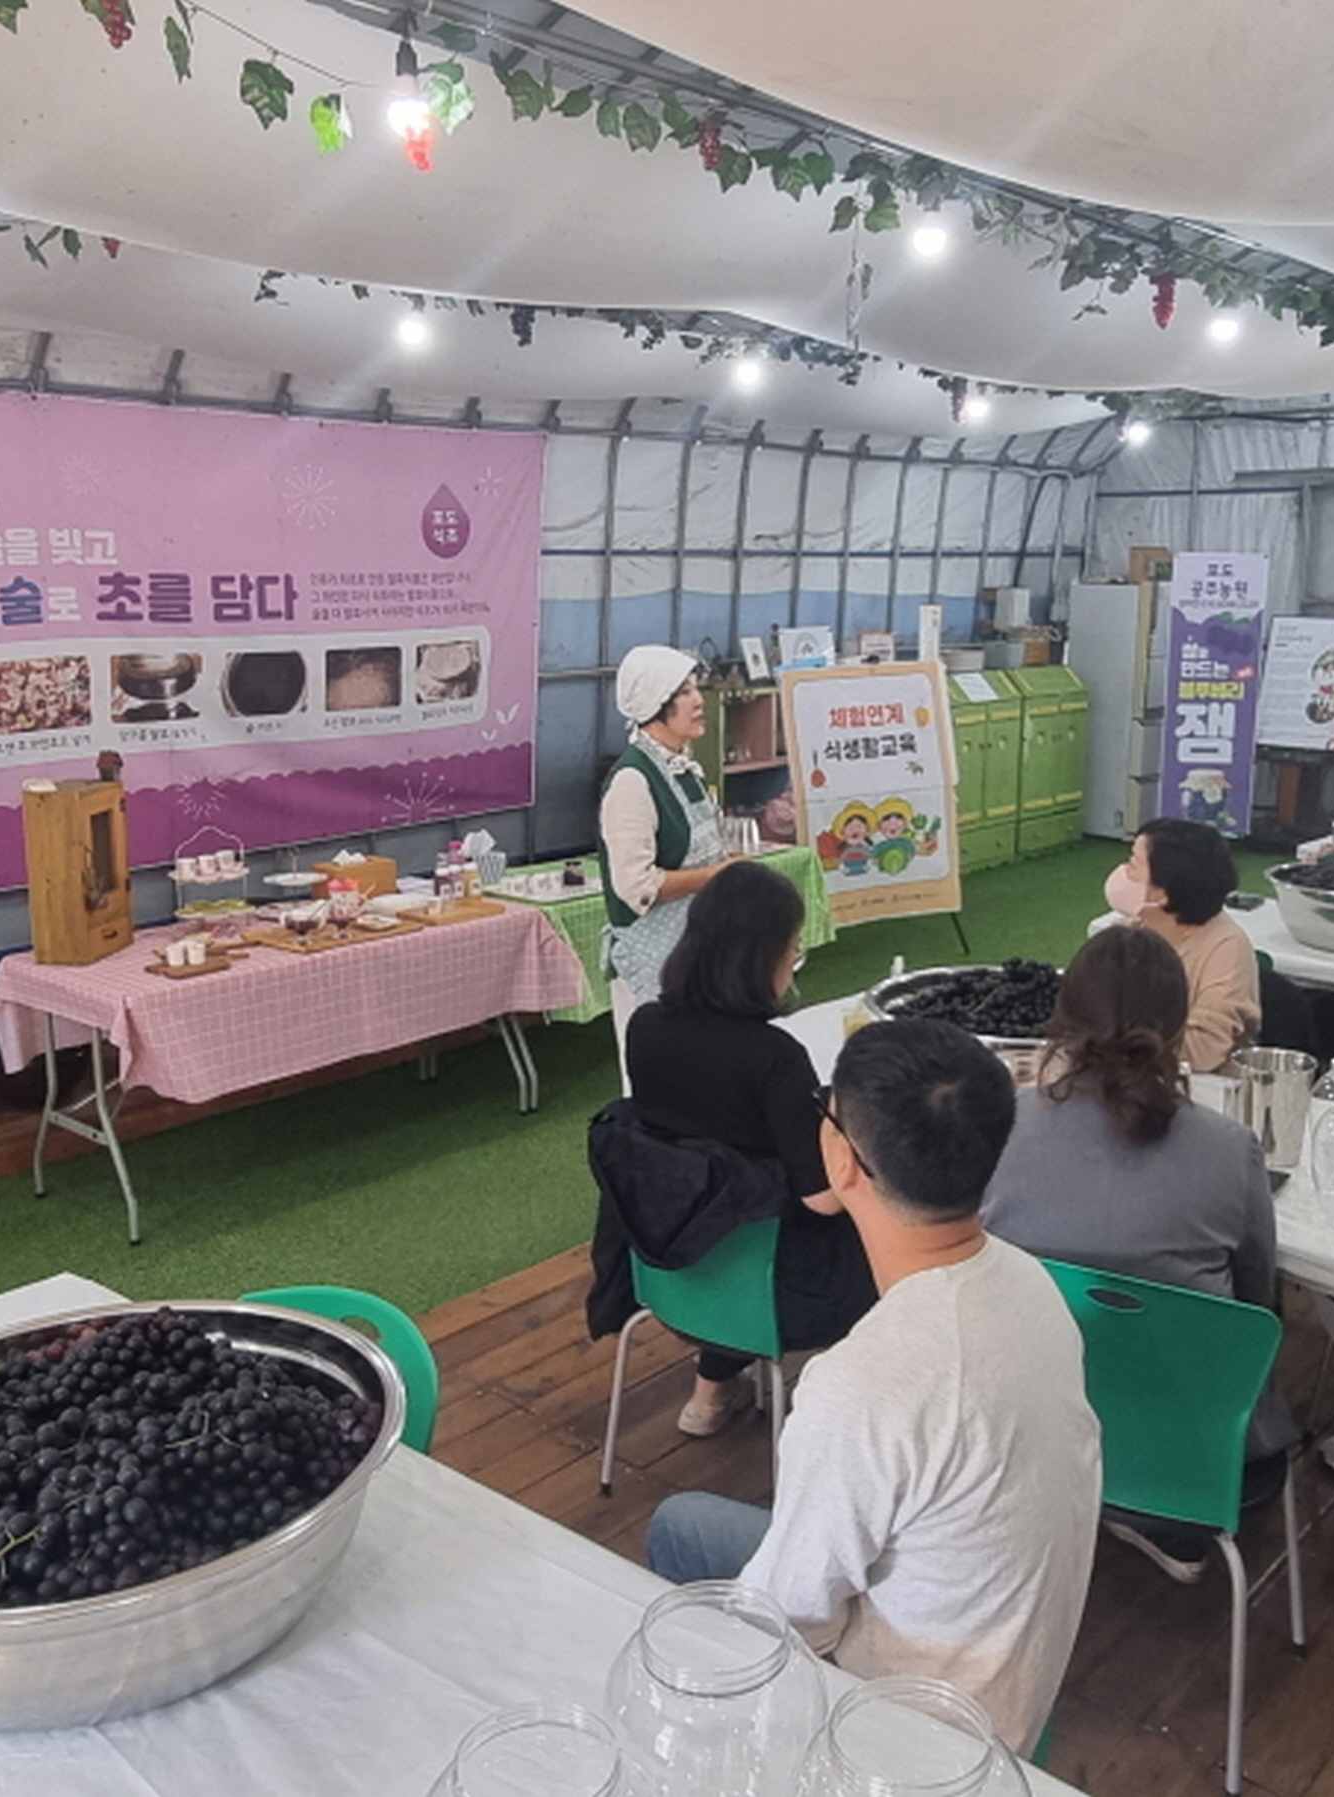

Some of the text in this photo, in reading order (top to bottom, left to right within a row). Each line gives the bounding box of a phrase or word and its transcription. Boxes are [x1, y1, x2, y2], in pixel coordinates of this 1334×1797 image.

[432, 510, 458, 525] 포도
[49, 527, 118, 566] 빚고
[96, 571, 193, 623] 초를
[210, 573, 299, 622] 담다
[1181, 661, 1230, 679] 만드는
[829, 703, 904, 729] 체험연계
[1175, 702, 1236, 763] 잼
[824, 733, 917, 762] 식생활교육
